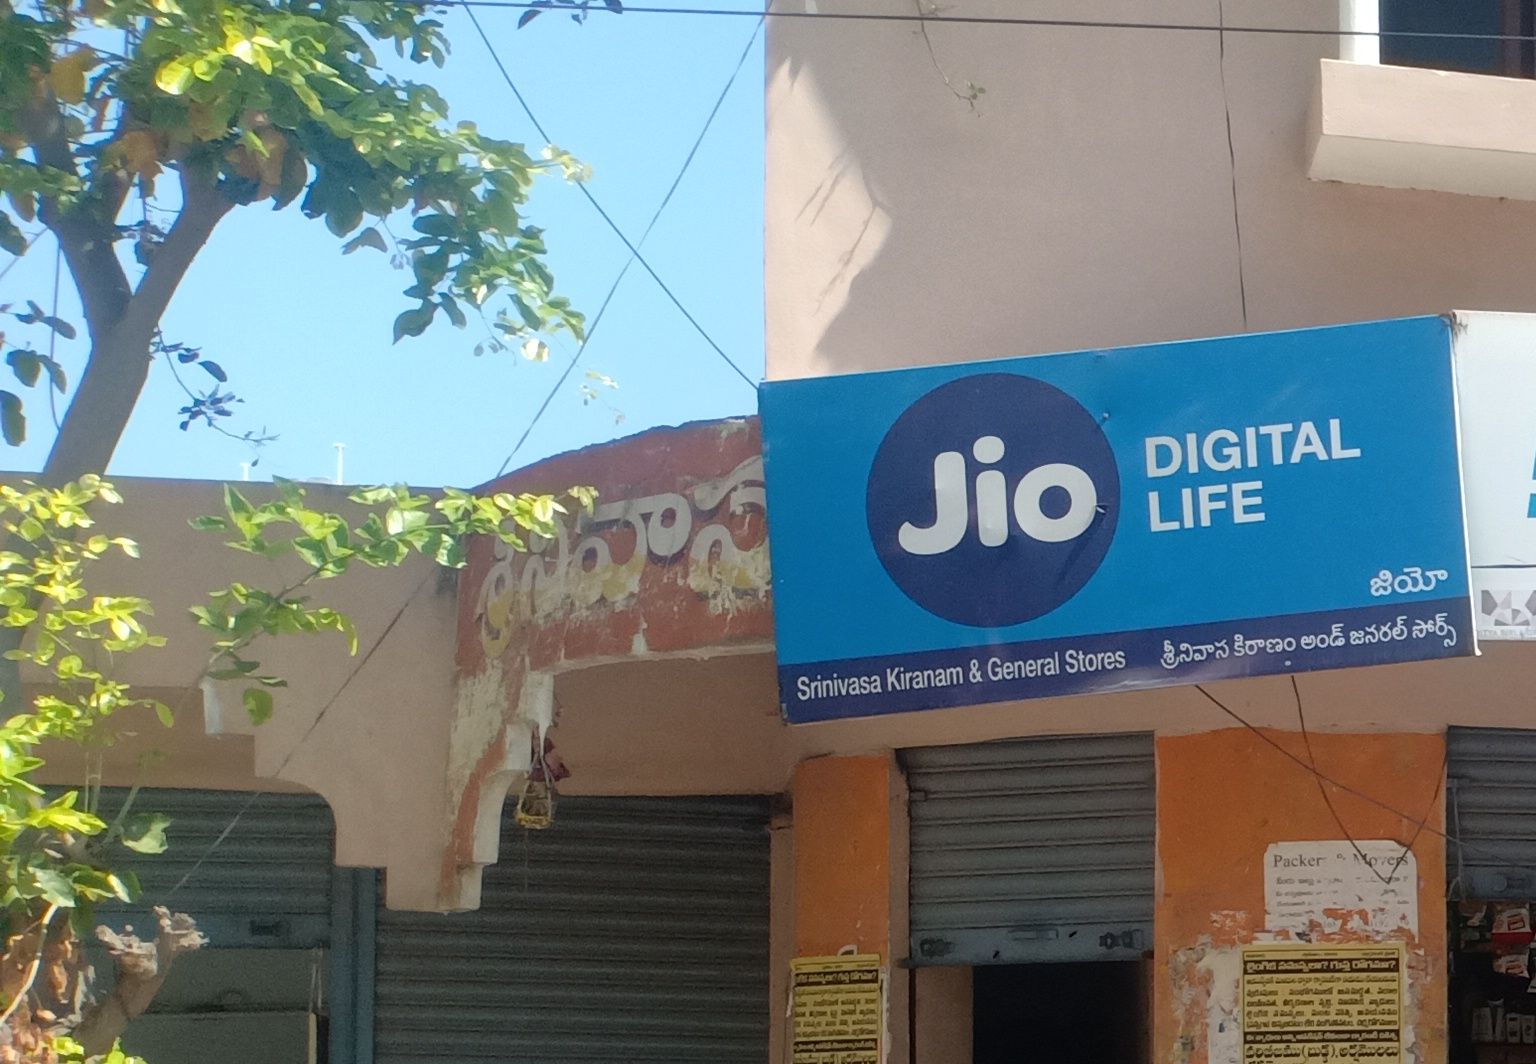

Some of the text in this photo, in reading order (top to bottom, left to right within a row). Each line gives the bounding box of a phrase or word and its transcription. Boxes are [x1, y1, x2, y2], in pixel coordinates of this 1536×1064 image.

[1144, 419, 1361, 478] DIGITAL
[898, 435, 1098, 555] Jio
[1148, 480, 1266, 533] LIFE
[796, 649, 1126, 701] Srinivasa Kiranam & General Stores
